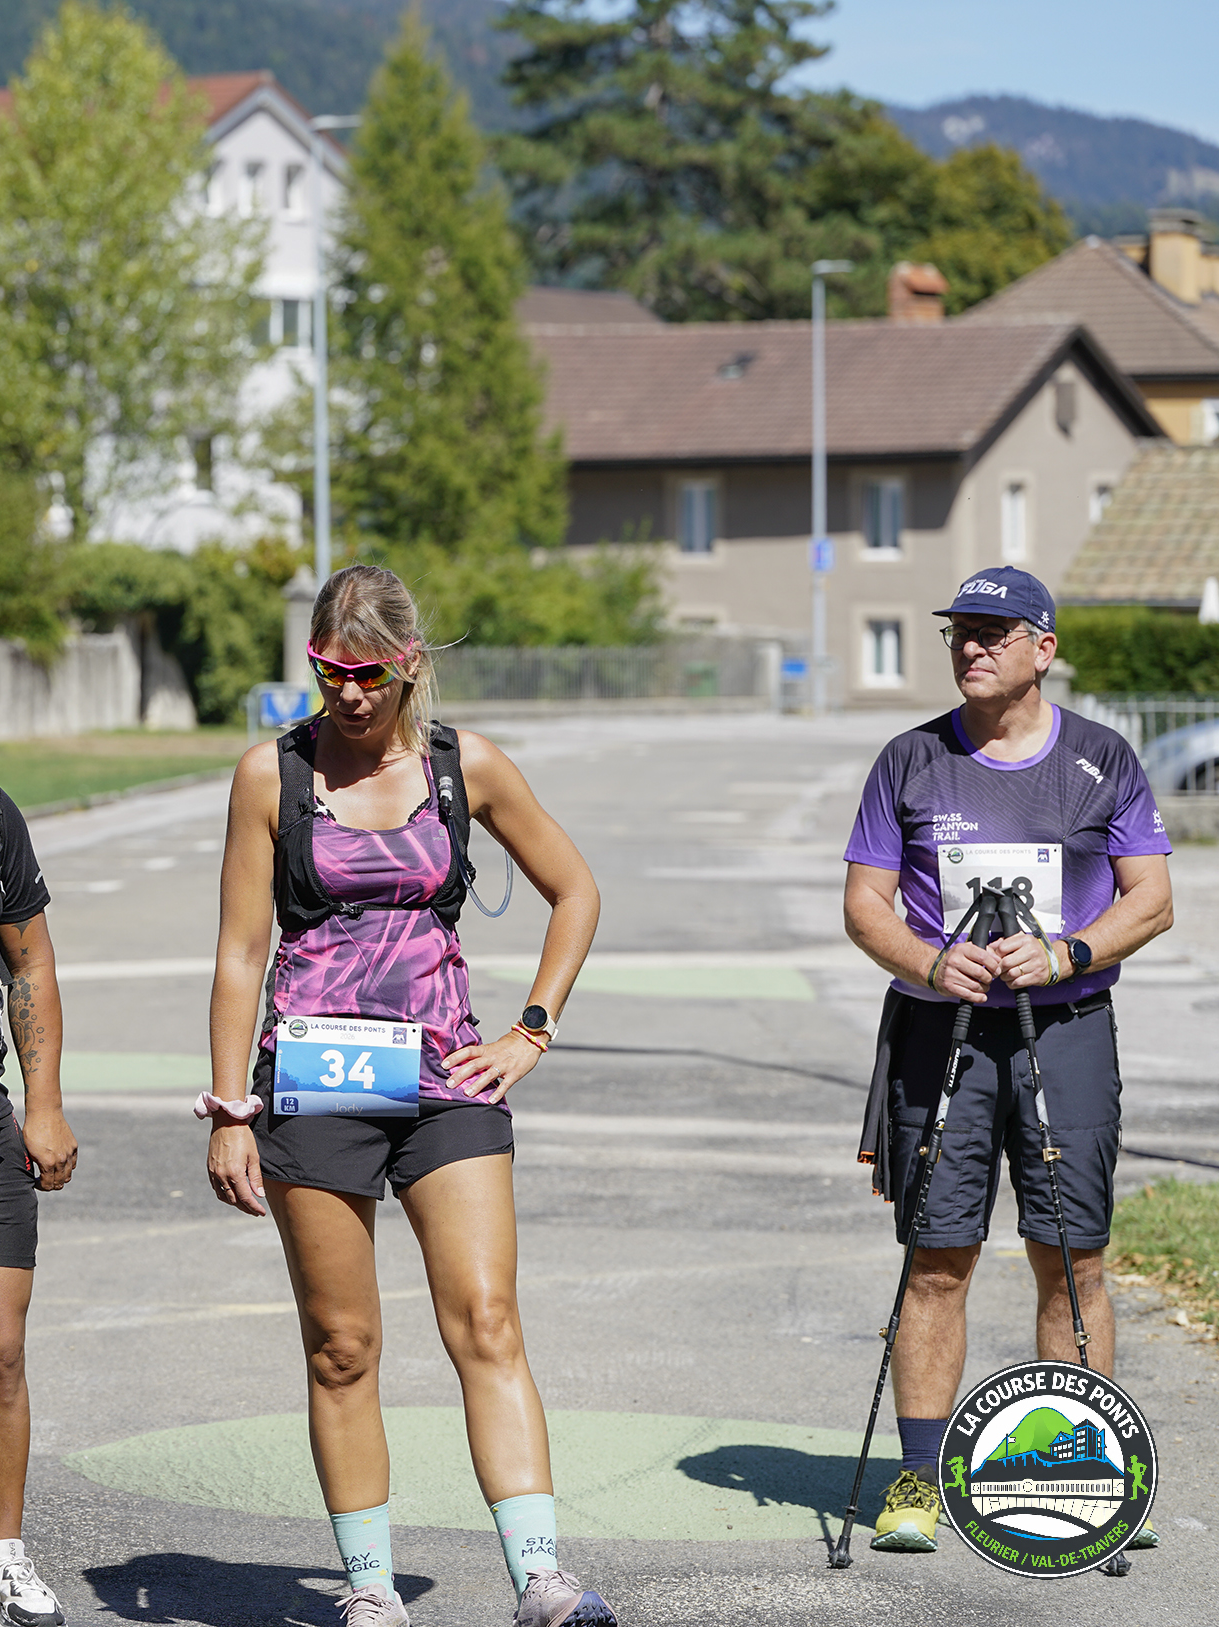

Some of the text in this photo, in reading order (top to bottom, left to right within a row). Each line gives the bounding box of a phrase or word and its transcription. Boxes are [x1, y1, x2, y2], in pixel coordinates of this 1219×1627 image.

[958, 578, 1008, 599] FUGA
[1075, 758, 1104, 784] FUGA
[933, 822, 978, 831] CANYON
[932, 831, 960, 841] TRAIL
[319, 1049, 376, 1090] 34
[330, 1103, 364, 1115] Jody
[526, 1536, 556, 1547] STA
[341, 1552, 371, 1566] TAY
[521, 1545, 557, 1559] MAG
